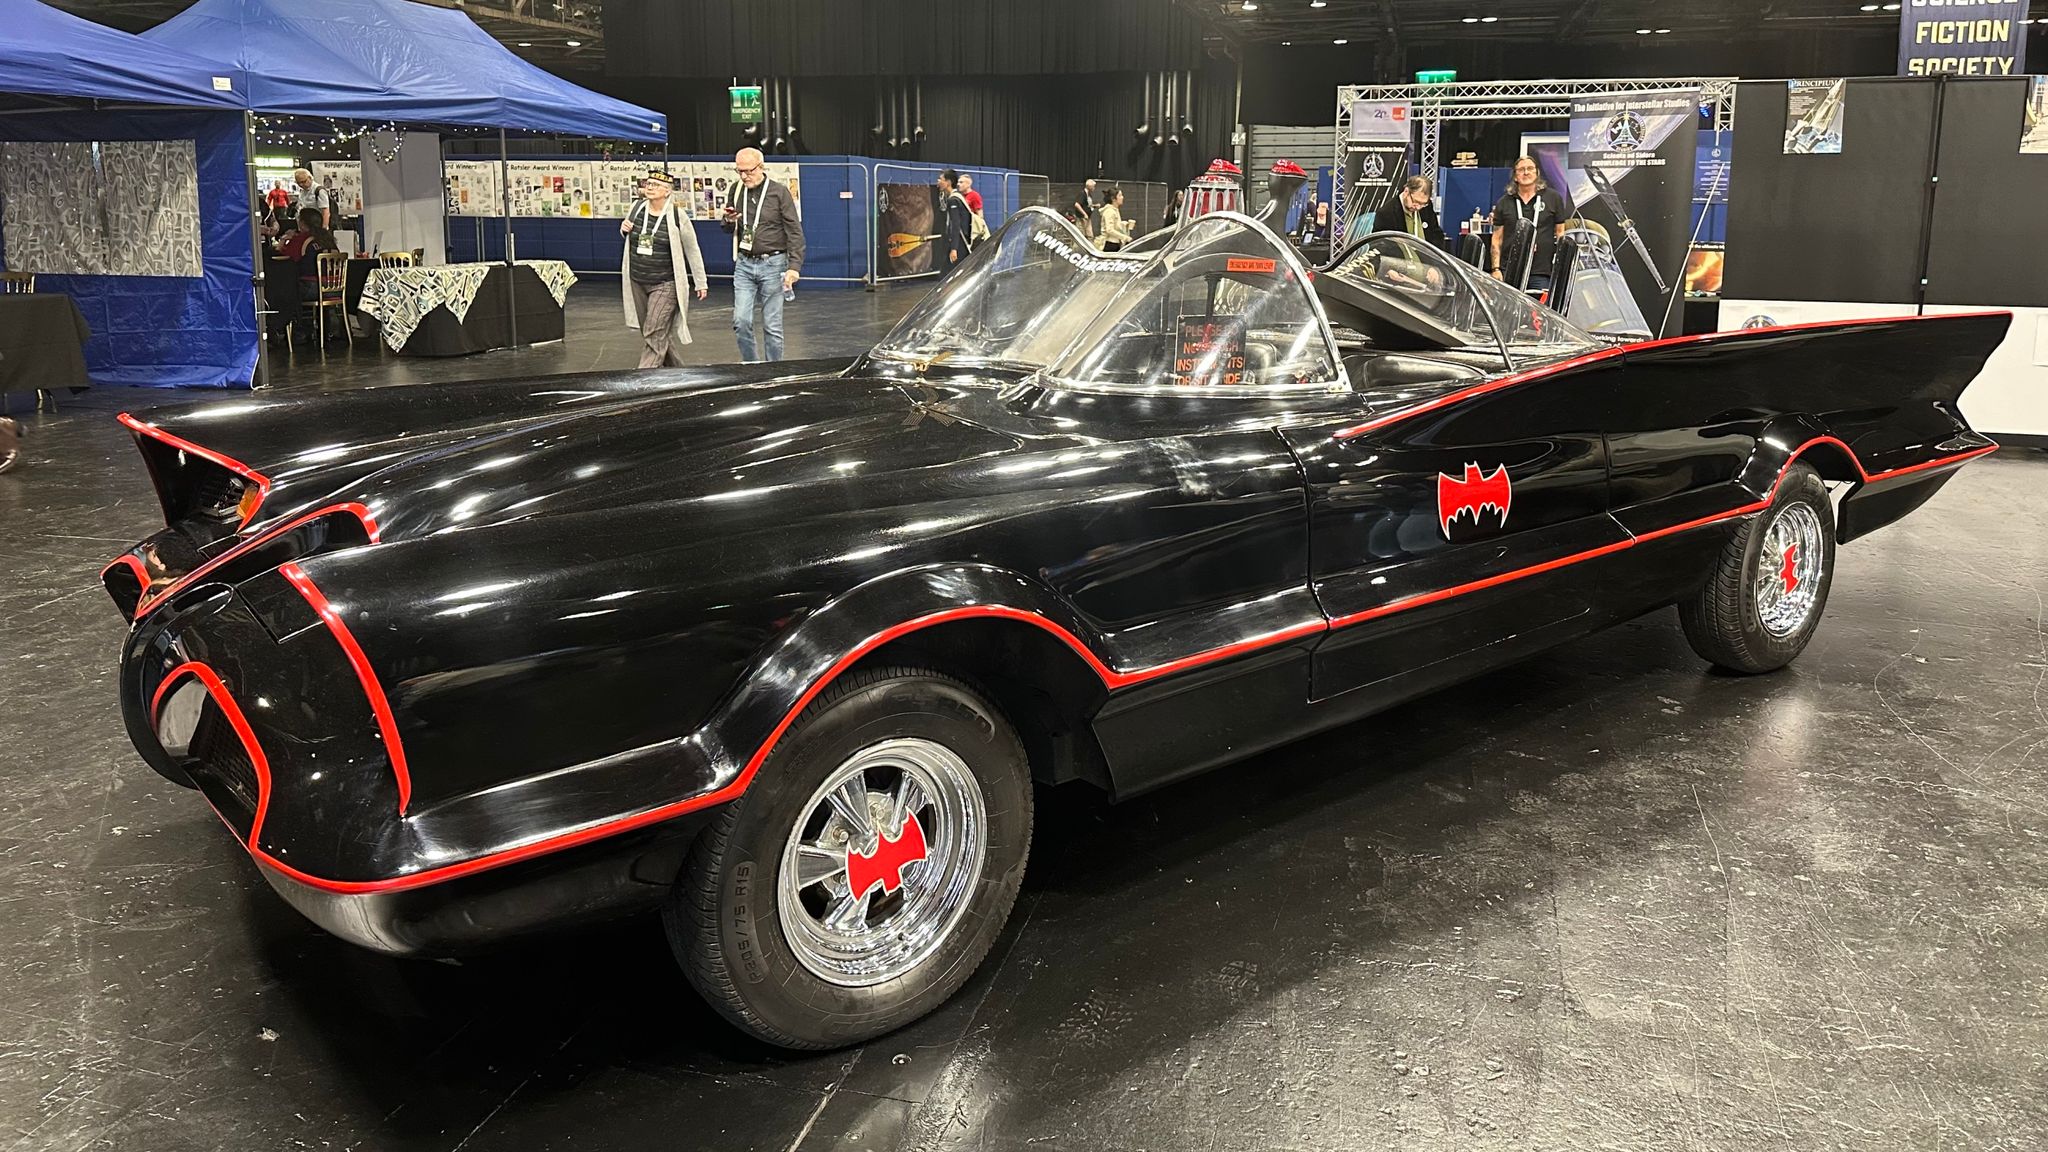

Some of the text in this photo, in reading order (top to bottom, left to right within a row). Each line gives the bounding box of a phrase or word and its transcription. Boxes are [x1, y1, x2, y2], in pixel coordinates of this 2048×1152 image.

[1915, 19, 2010, 44] FICTION
[1574, 98, 1690, 112] The Initiative for Interstellar Studies
[1185, 323, 1222, 337] PLESE
[735, 866, 750, 896] R15
